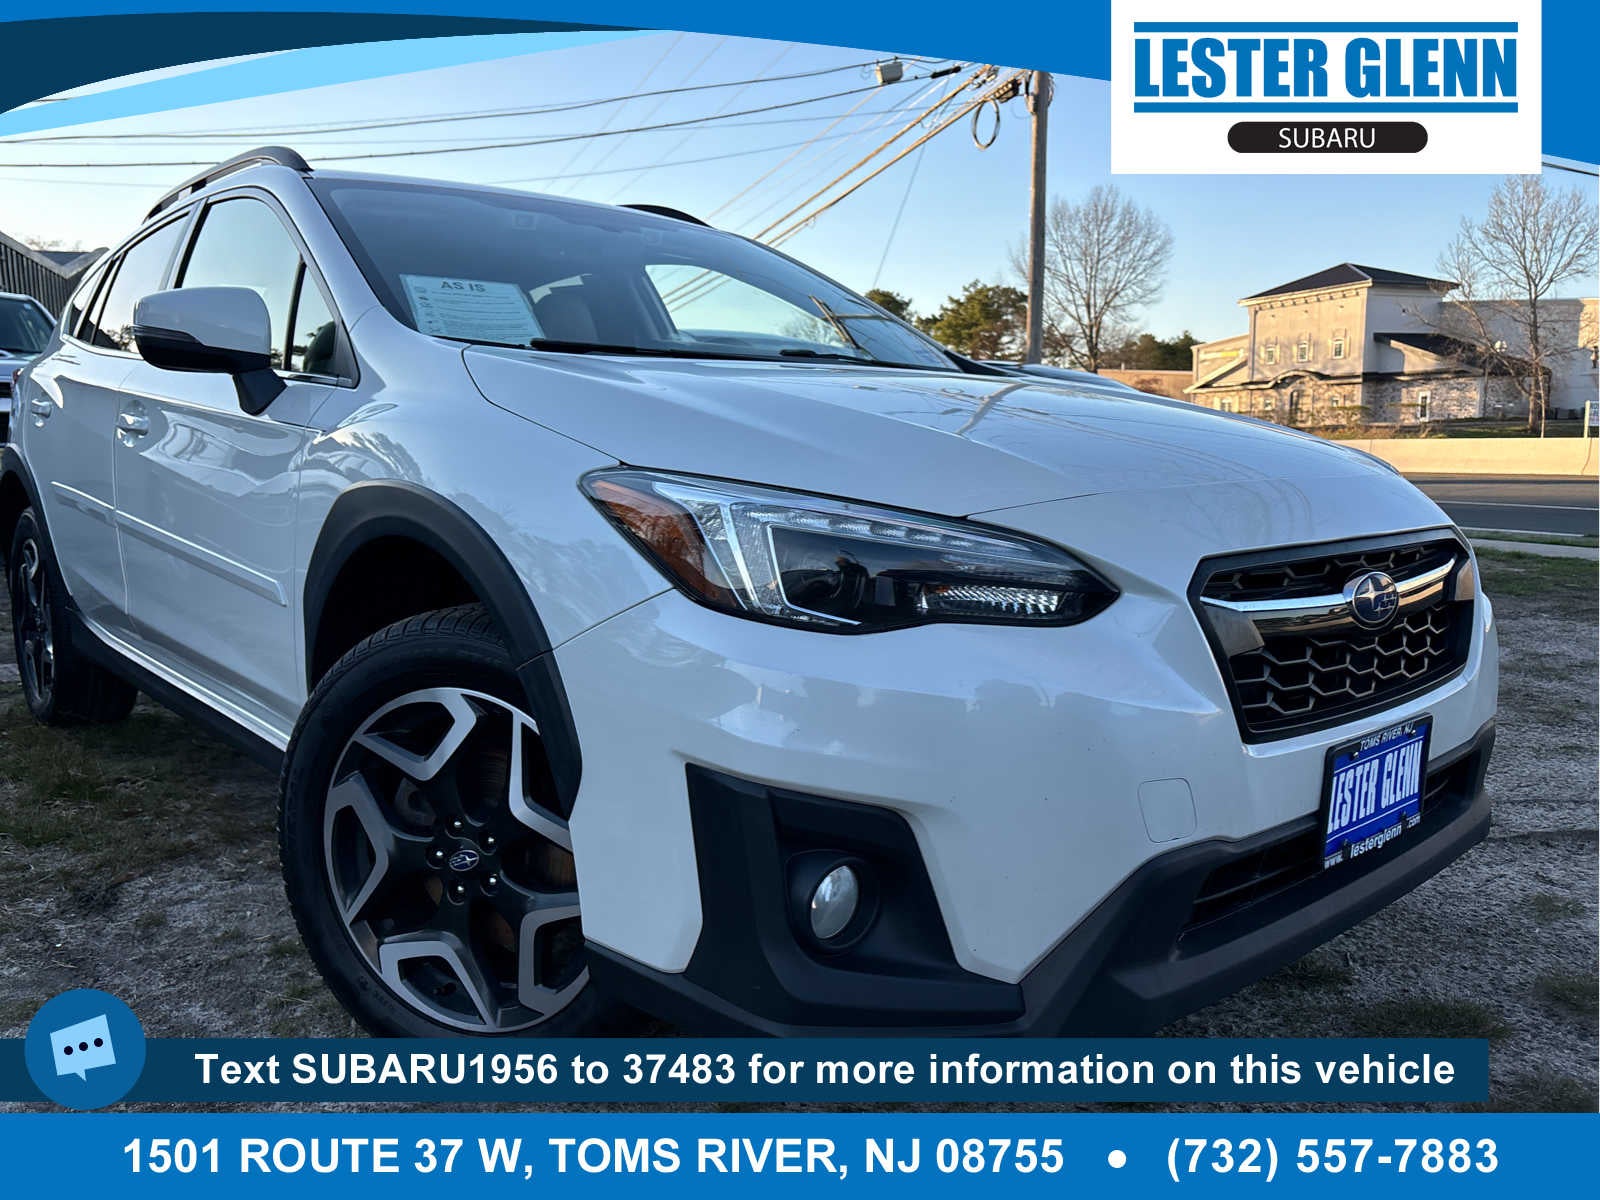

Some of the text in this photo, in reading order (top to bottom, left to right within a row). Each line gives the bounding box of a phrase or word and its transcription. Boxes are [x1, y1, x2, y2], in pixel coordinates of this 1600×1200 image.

[440, 280, 487, 293] AS IS
[1360, 733, 1381, 751] TOMS
[1404, 721, 1413, 735] NJ
[1327, 740, 1423, 835] LESTER GLENN
[1350, 825, 1402, 858] lesterglenn
